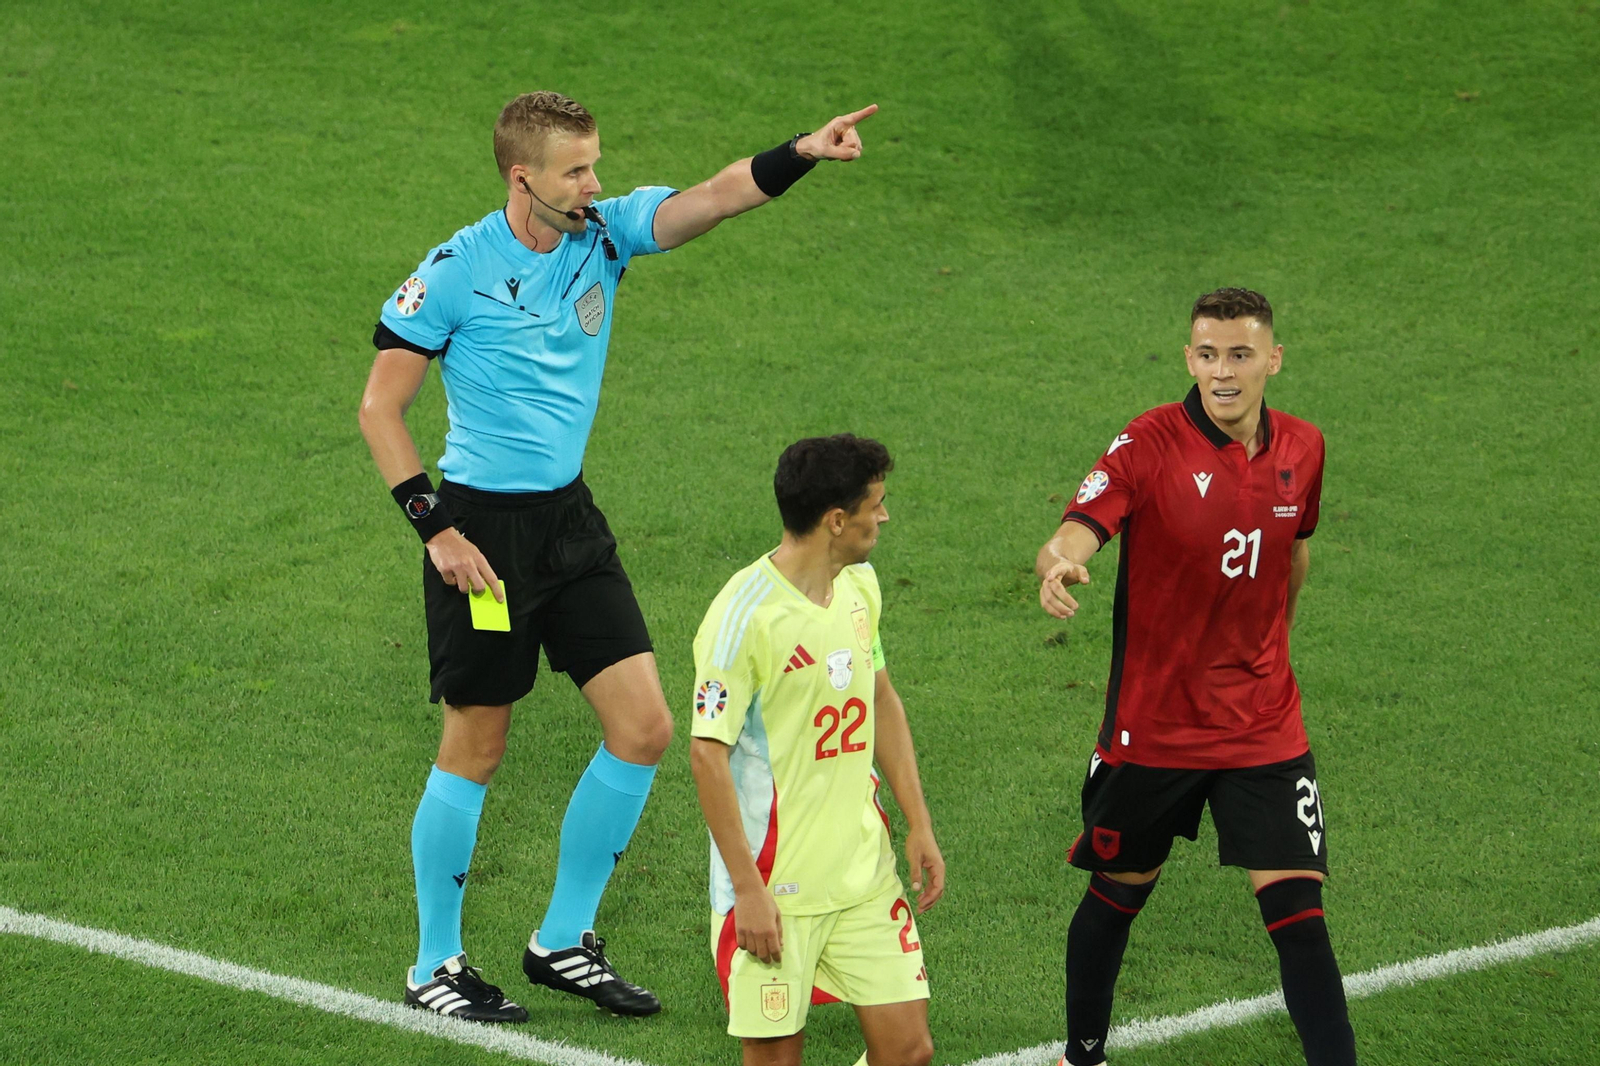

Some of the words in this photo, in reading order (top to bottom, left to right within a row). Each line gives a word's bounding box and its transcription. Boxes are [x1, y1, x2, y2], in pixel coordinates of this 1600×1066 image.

[584, 310, 602, 328] OFFICIAL
[585, 304, 600, 319] MATCH
[1221, 528, 1262, 579] 21
[813, 697, 867, 761] 22
[1296, 776, 1323, 829] 21
